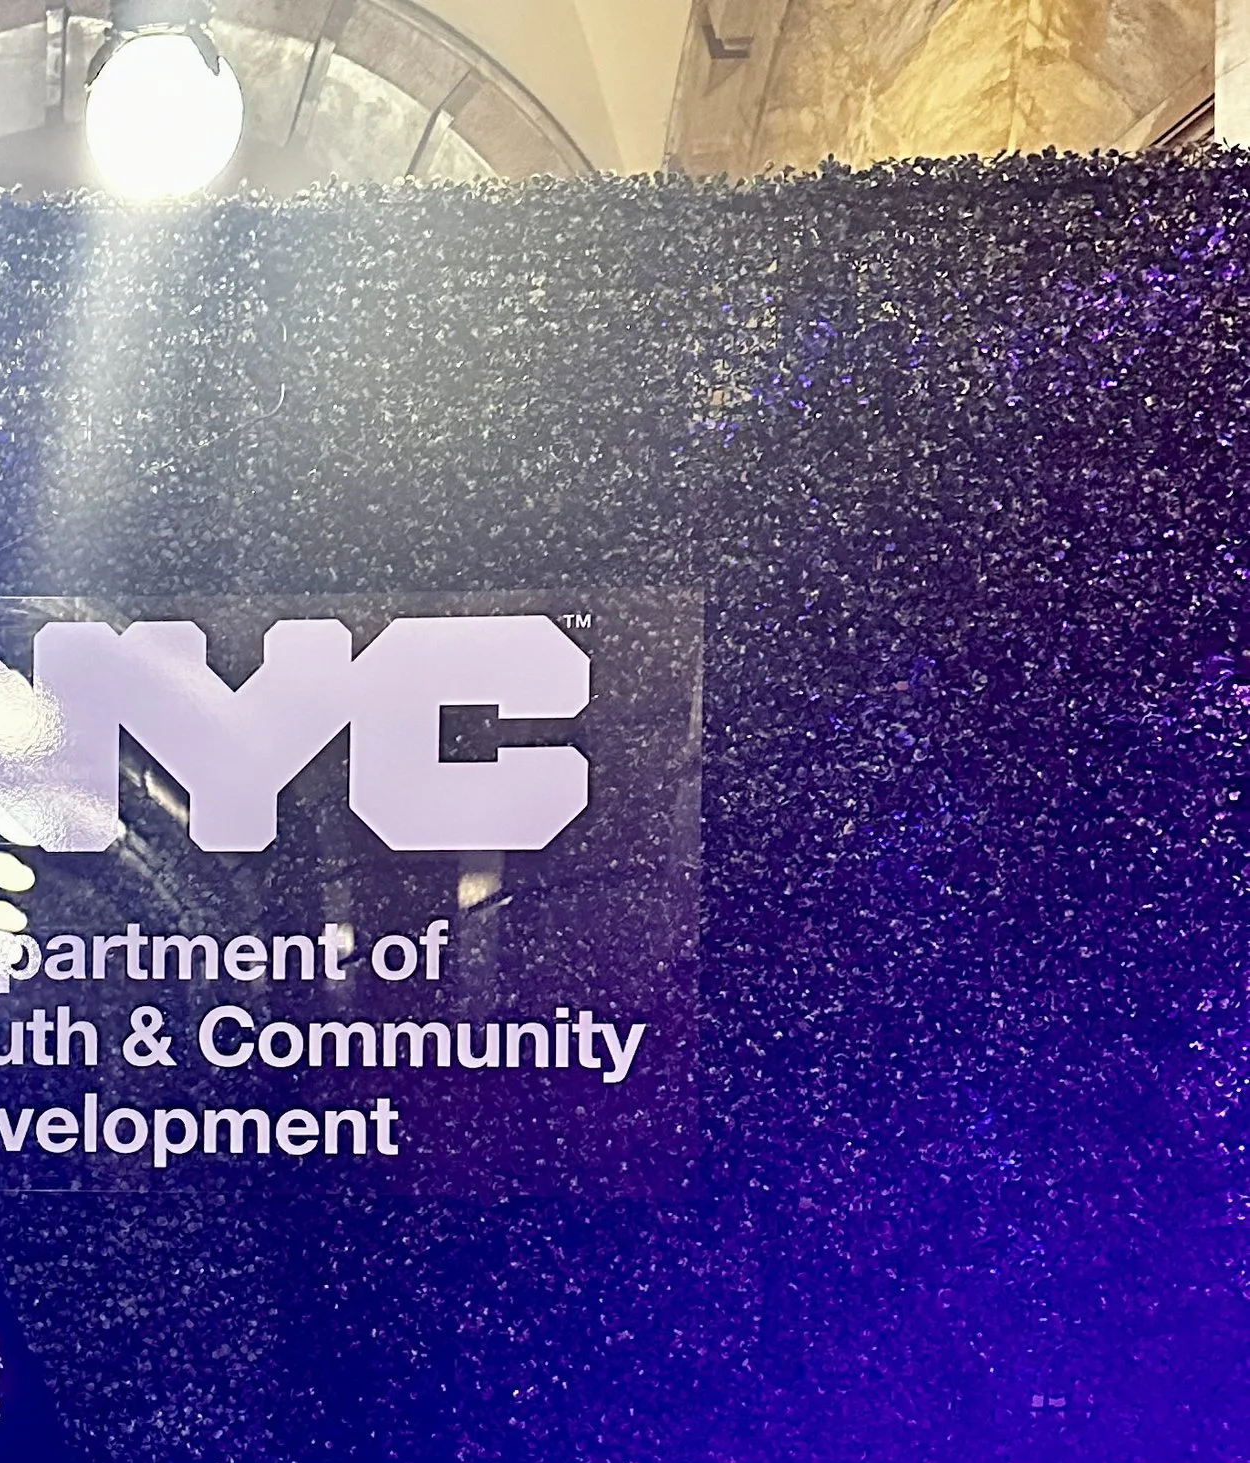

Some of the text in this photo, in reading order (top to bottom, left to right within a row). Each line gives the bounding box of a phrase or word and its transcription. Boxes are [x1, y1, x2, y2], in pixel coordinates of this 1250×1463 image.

[371, 919, 449, 981] of
[121, 1006, 178, 1067] &
[198, 1005, 646, 1084] Community
